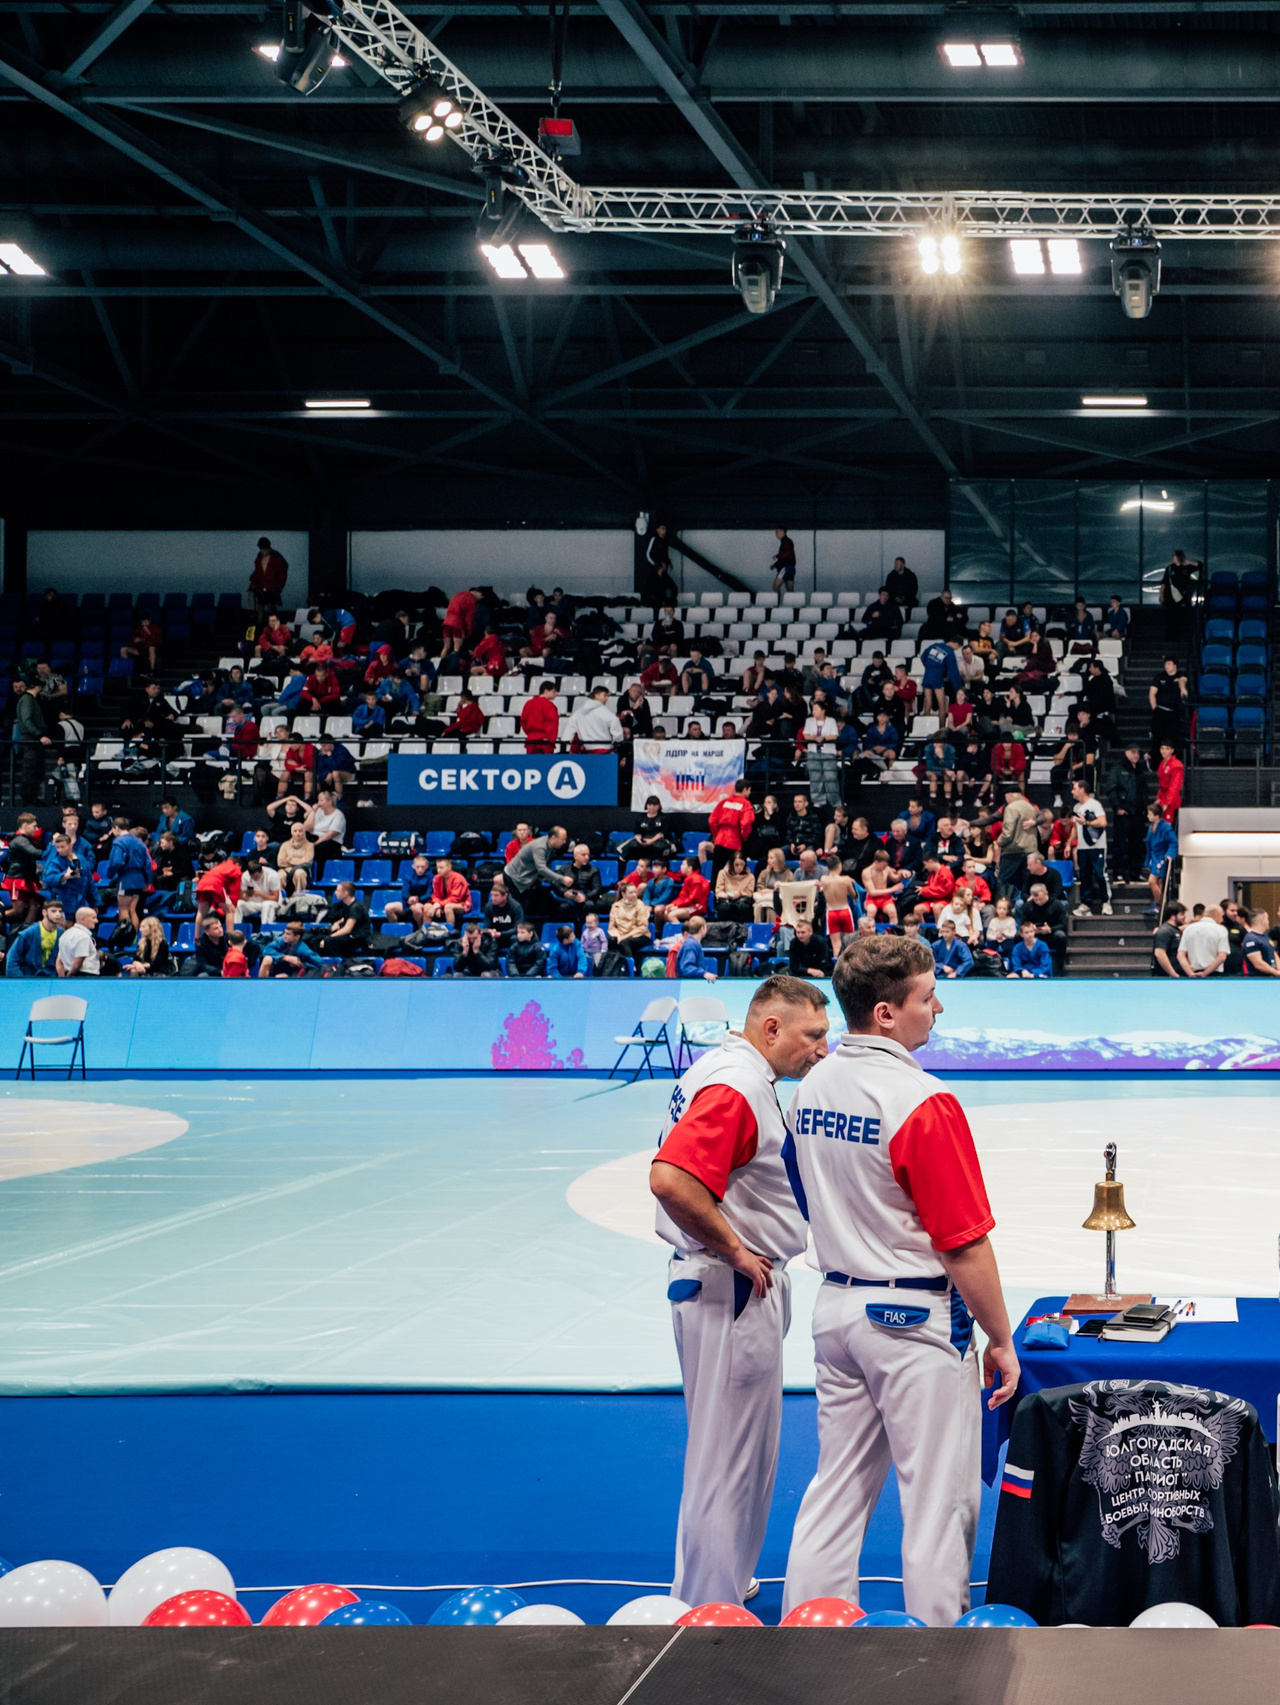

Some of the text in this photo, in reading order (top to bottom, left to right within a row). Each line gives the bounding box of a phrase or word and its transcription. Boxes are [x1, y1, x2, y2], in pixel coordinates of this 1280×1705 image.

[665, 749, 688, 758] ЛДПР
[418, 768, 542, 791] СЕКТОР
[796, 1108, 881, 1145] REFEREE
[883, 1310, 907, 1325] FIAS
[1130, 1454, 1183, 1469] ОБЛАСТЬ
[1111, 1488, 1145, 1507] ЦЕНТР
[1105, 1502, 1149, 1524] БОЕВЫХ
